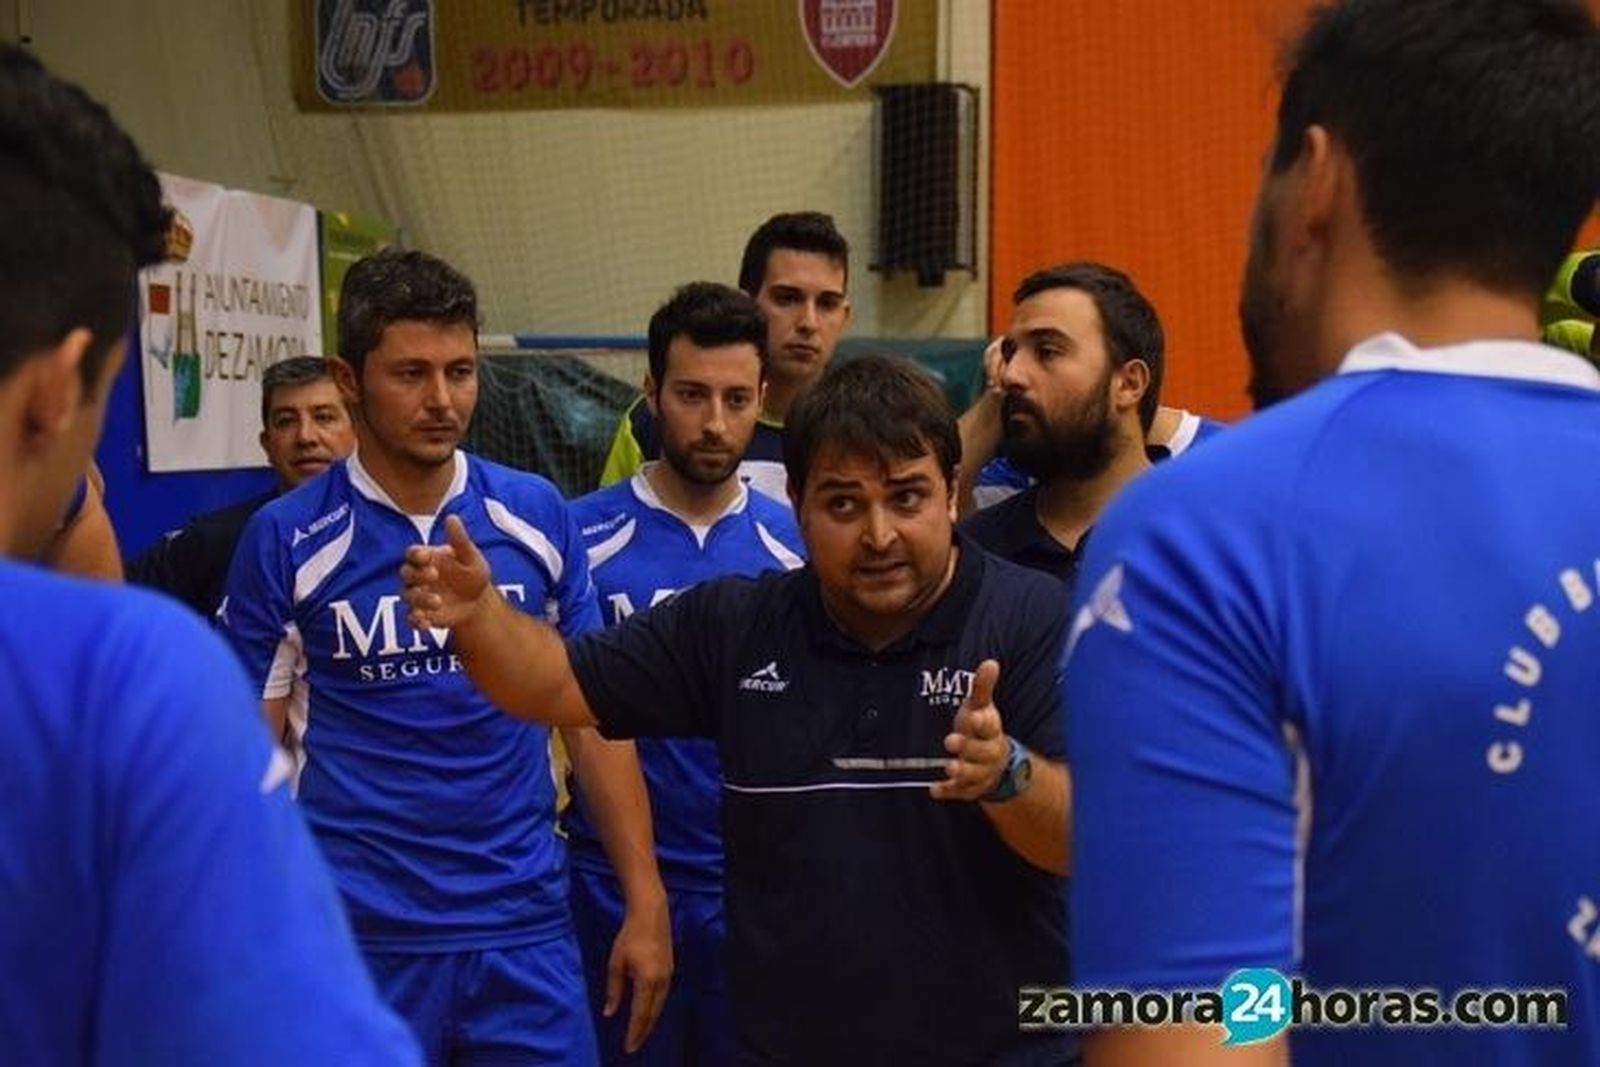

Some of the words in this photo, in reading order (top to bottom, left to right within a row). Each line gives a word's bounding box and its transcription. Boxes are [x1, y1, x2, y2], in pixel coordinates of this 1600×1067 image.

[512, 0, 709, 26] TEMPORADA
[471, 38, 756, 92] 2009-2010
[204, 272, 309, 320] AYUNTAMIENTO
[1486, 603, 1562, 774] CLUB
[1558, 557, 1600, 613] B
